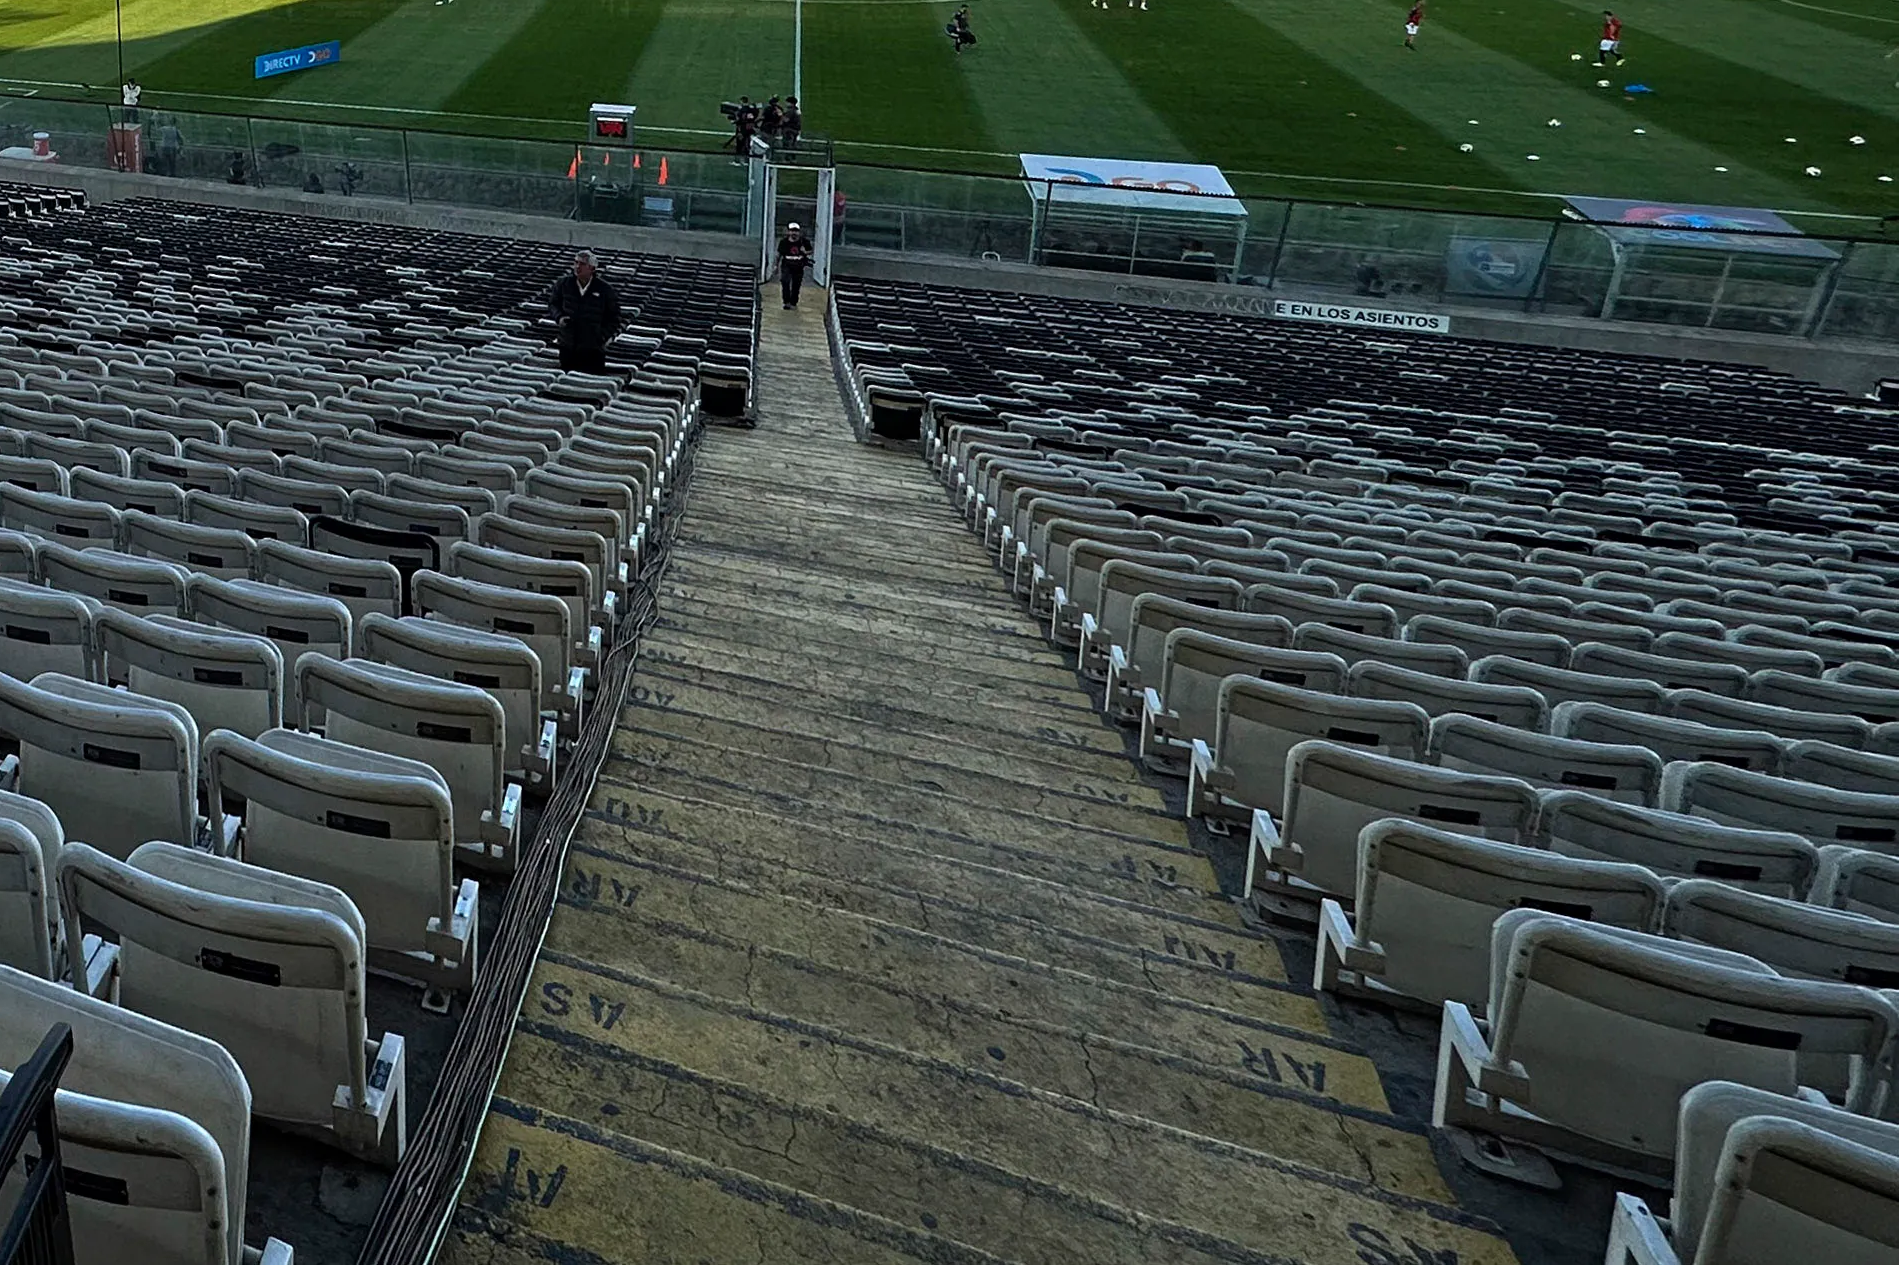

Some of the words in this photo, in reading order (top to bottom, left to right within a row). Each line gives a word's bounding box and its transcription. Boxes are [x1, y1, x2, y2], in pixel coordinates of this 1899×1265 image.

[264, 54, 301, 73] DIRECTV
[1291, 304, 1313, 317] EN
[1317, 308, 1351, 320] LOS
[1354, 310, 1440, 329] ASIENTOS
[569, 868, 643, 908] AR
[540, 982, 627, 1030] AS
[1235, 1039, 1326, 1093] AR
